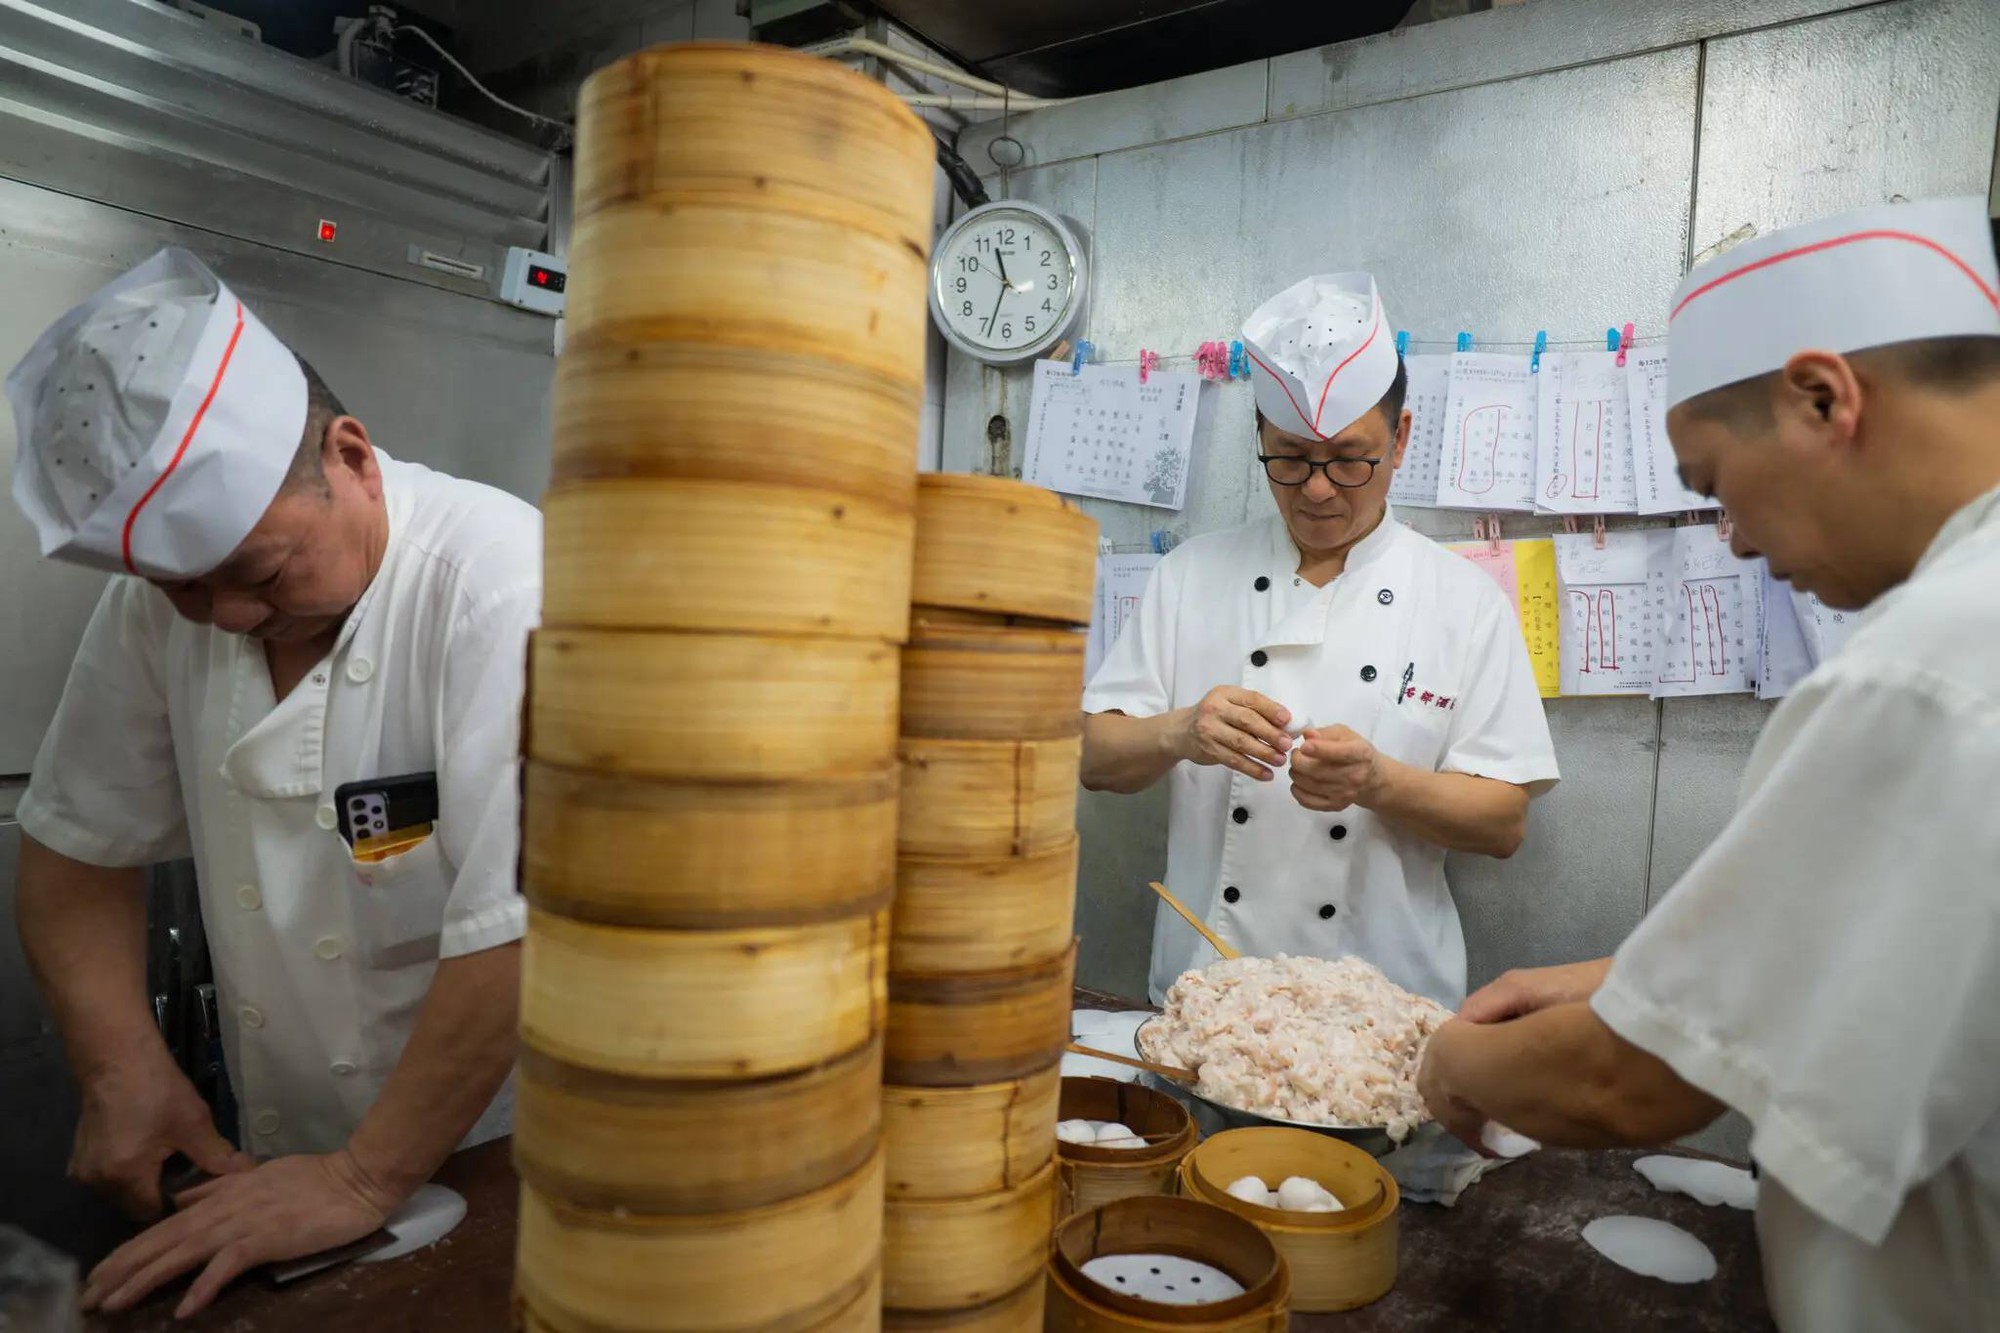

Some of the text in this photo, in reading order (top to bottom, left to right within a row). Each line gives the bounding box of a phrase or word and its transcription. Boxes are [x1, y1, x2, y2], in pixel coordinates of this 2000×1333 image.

[975, 238, 990, 252] 11
[996, 229, 1015, 245] 12
[1024, 236, 1030, 250] 1
[959, 256, 979, 272] 10
[1040, 250, 1051, 266] 2
[956, 277, 967, 293] 9
[1047, 274, 1058, 290] 3
[962, 300, 973, 316] 8
[1041, 298, 1051, 312] 4
[979, 317, 989, 332] 7
[1001, 322, 1012, 338] 6
[1025, 316, 1035, 331] 5
